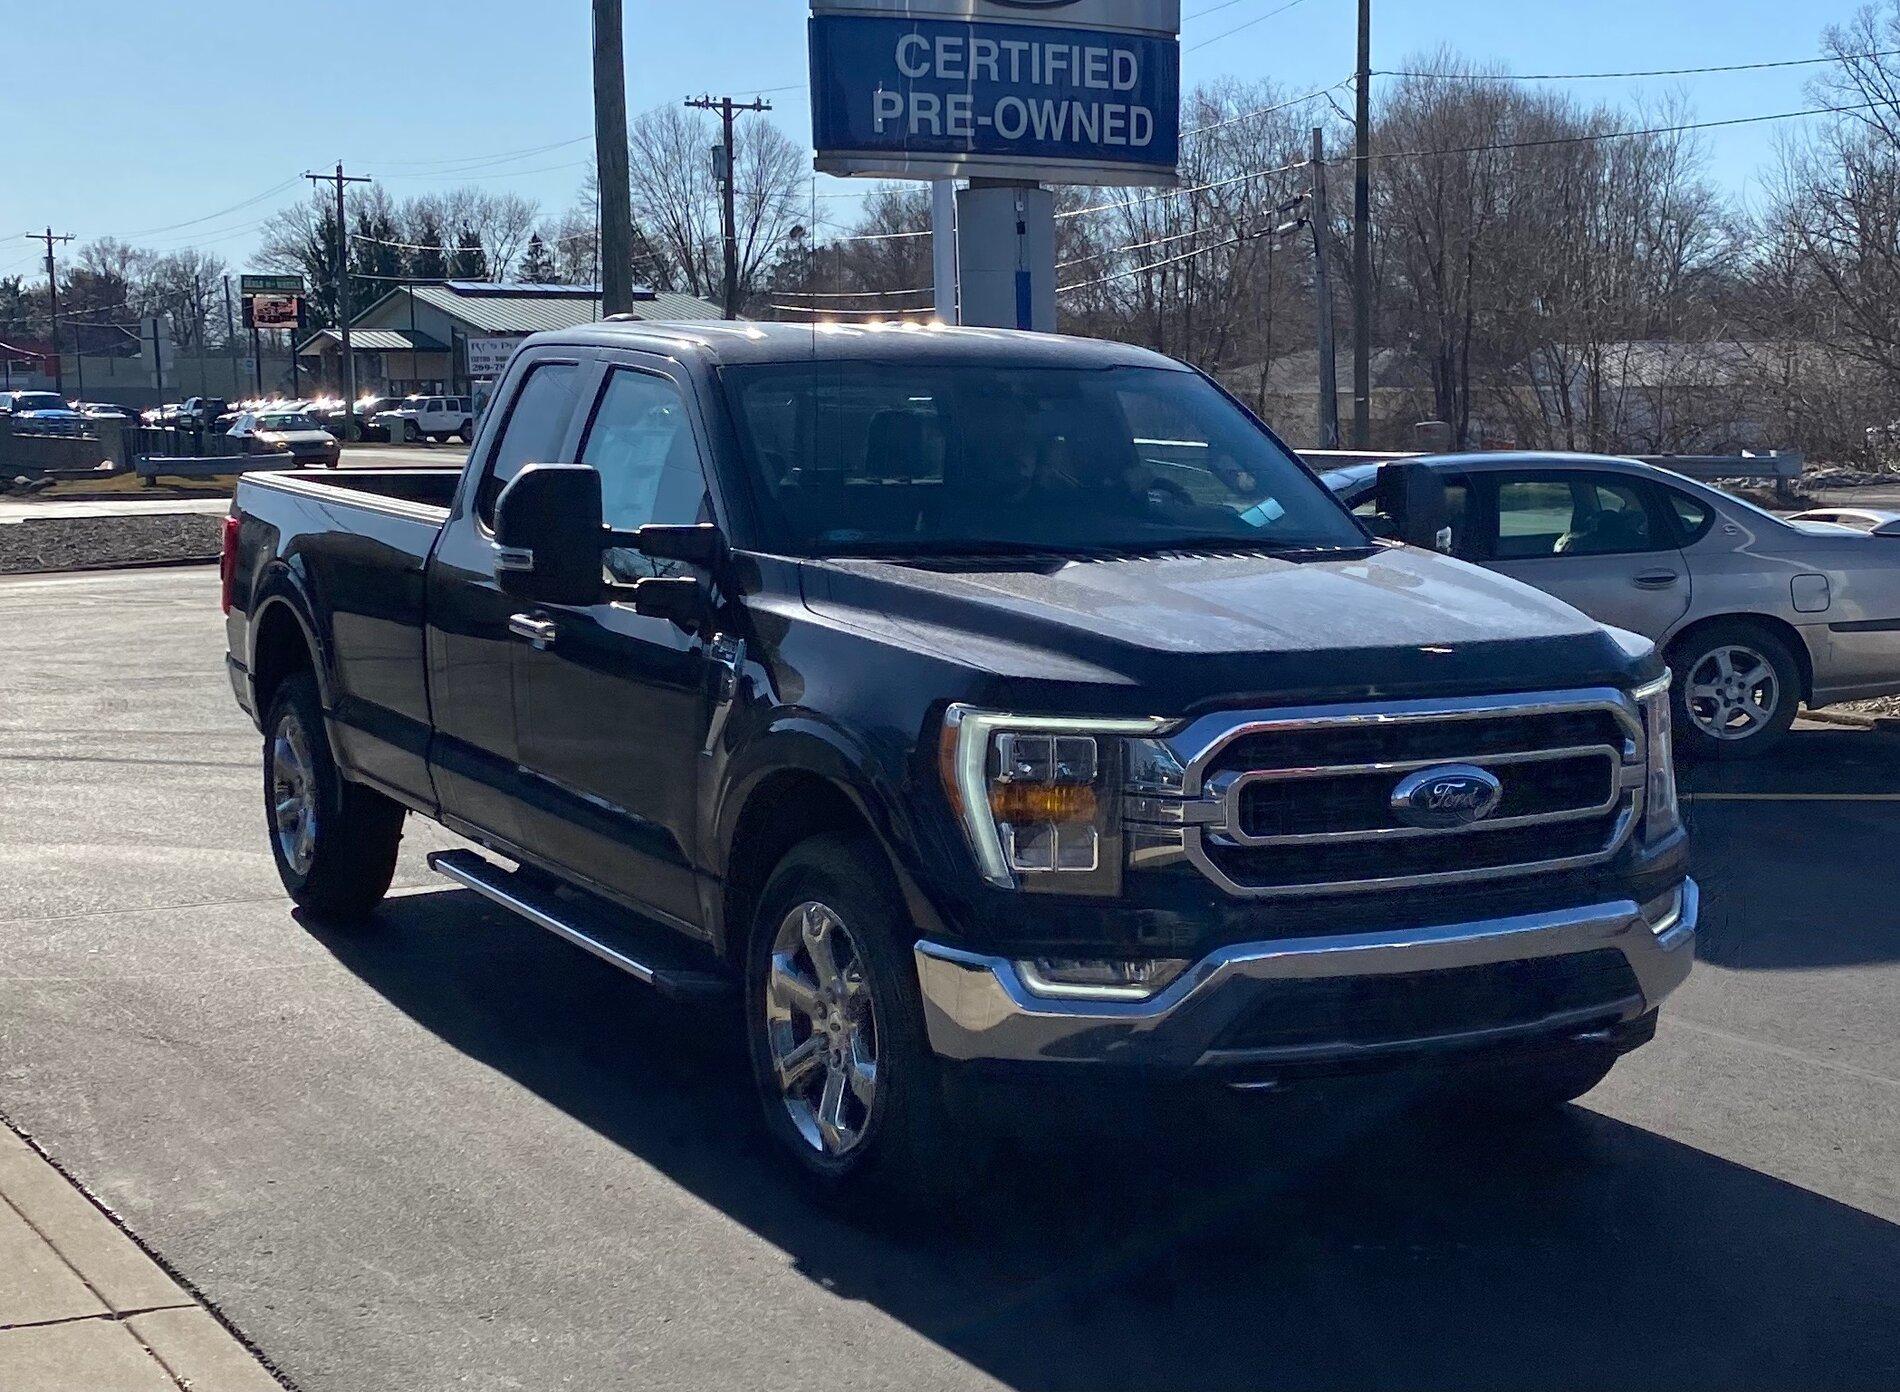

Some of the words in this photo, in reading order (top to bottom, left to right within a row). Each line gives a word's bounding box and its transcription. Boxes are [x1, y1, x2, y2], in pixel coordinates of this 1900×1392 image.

[895, 33, 1139, 91] CERTIFIED
[872, 90, 1154, 147] PRE-OWNED
[1428, 781, 1480, 809] Ford
